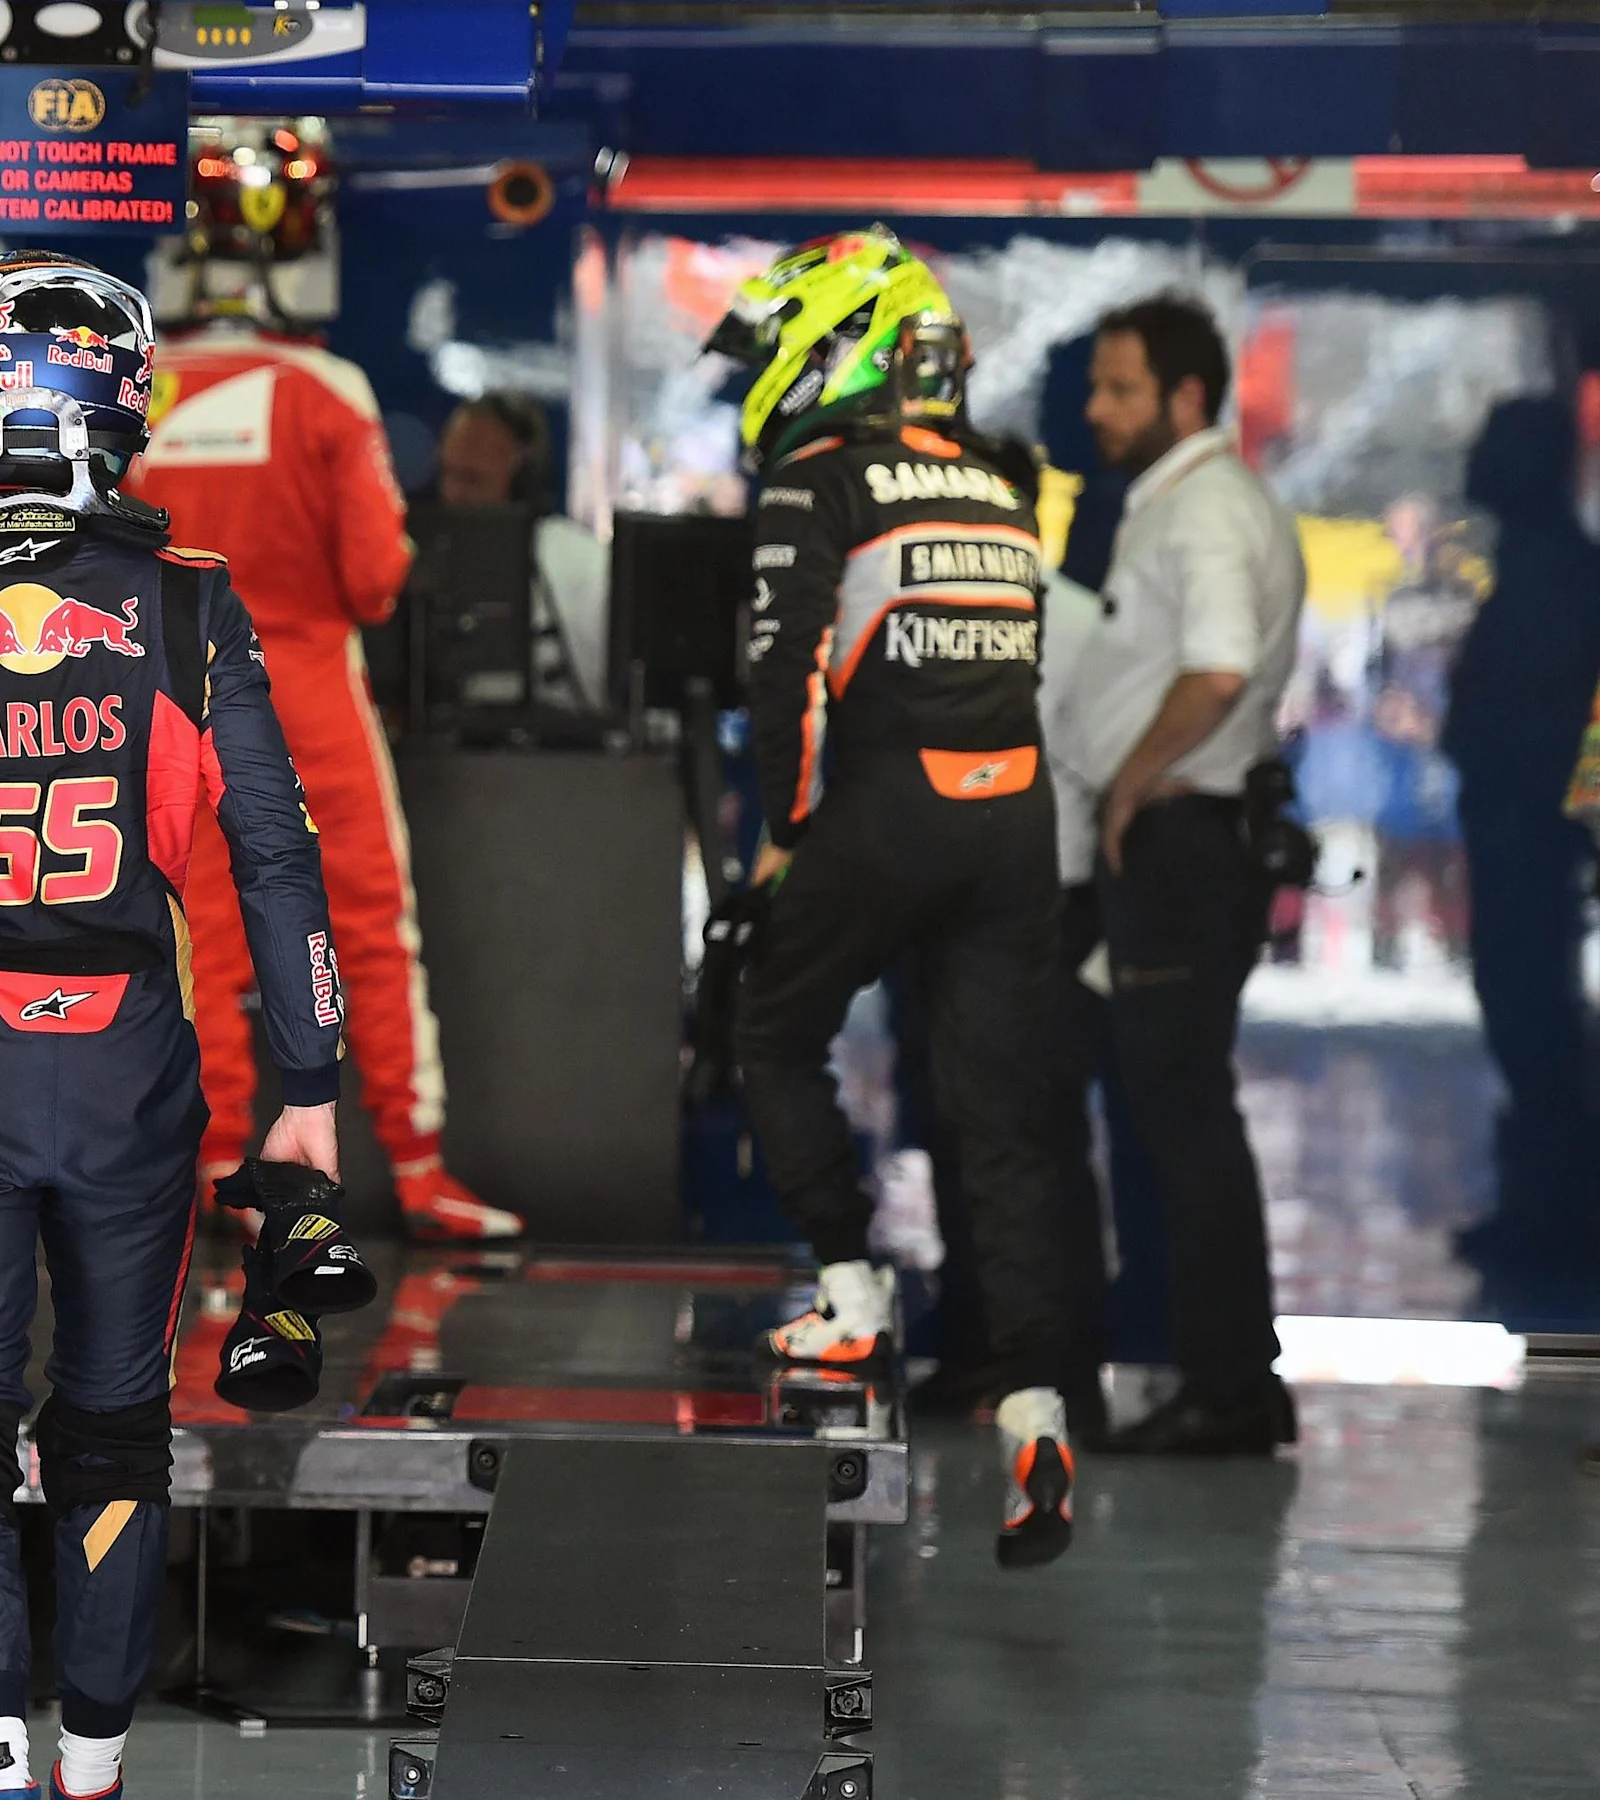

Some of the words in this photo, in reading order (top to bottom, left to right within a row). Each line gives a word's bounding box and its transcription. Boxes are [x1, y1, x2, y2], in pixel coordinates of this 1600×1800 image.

[35, 141, 101, 164] TOUCH
[106, 143, 177, 166] FRAME
[1, 169, 30, 191] OR
[34, 170, 133, 193] CAMERAS
[44, 200, 173, 223] CALIBRATED!
